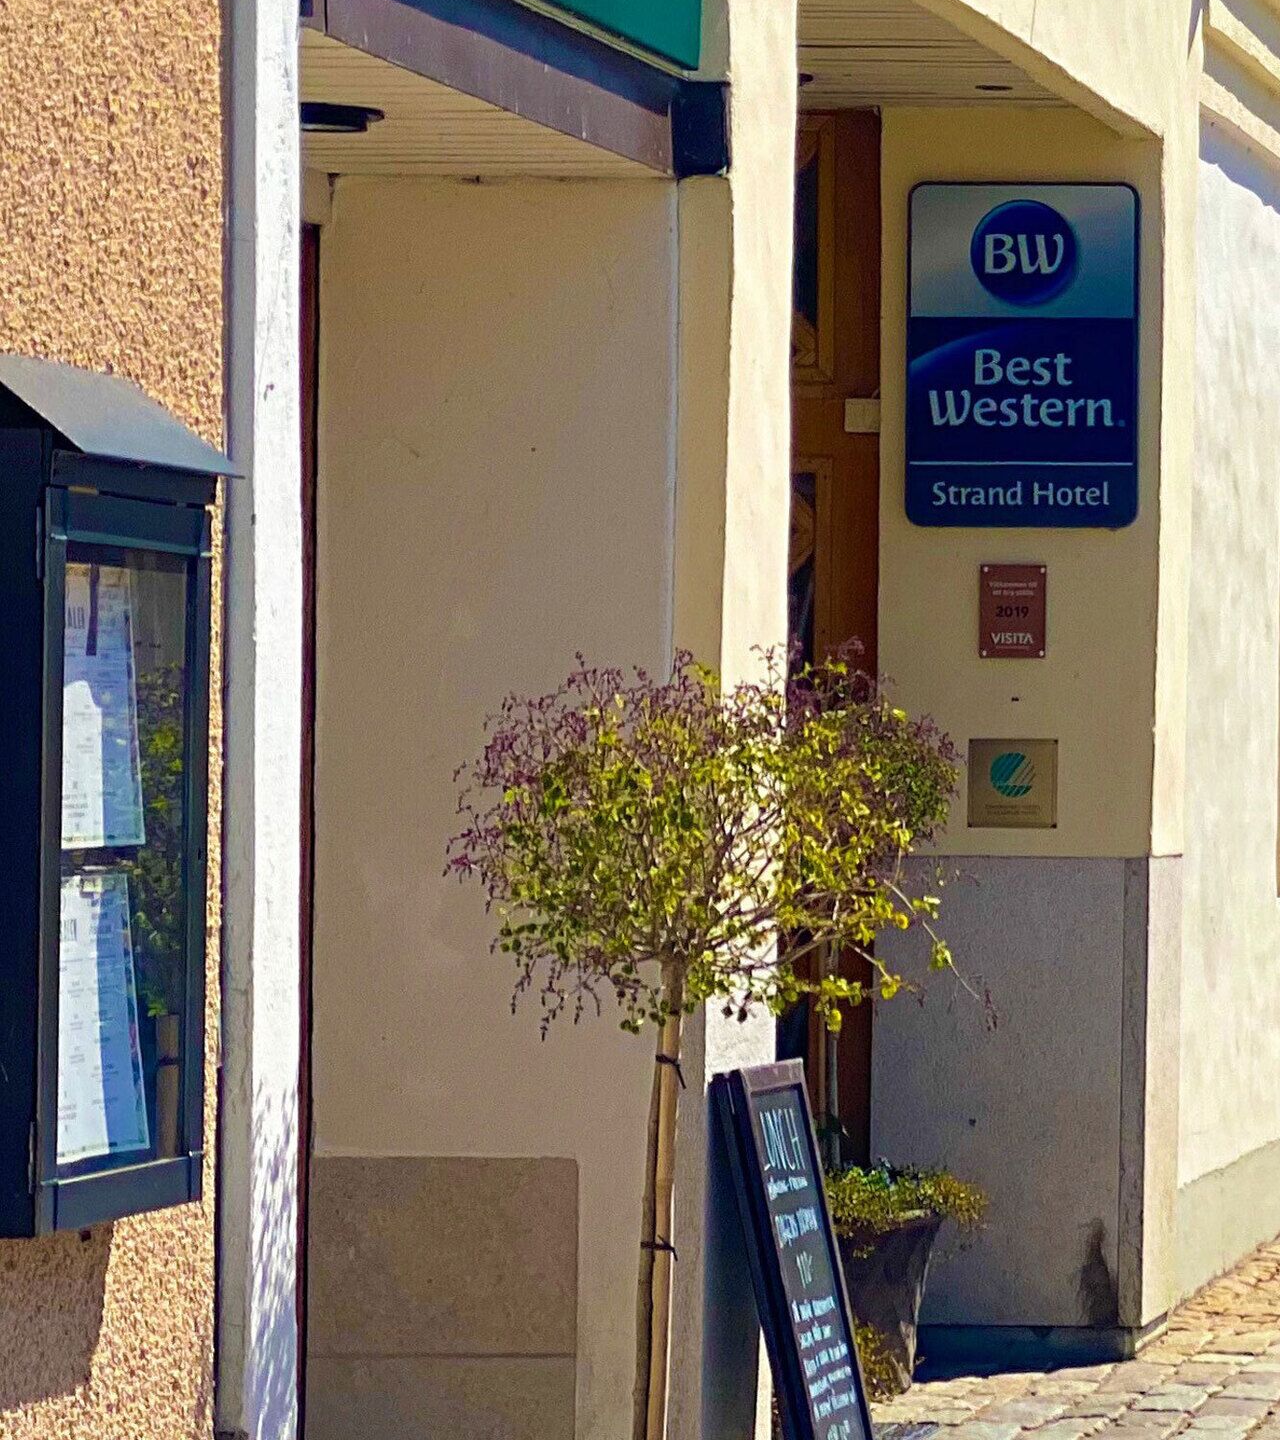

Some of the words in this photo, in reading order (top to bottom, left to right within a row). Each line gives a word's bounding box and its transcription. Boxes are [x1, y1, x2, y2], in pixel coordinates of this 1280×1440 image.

[983, 232, 1065, 275] BW
[974, 348, 1073, 386] Best
[931, 481, 1023, 506] Strand
[1032, 482, 1110, 506] Hotel
[759, 1108, 806, 1171] UNCH
